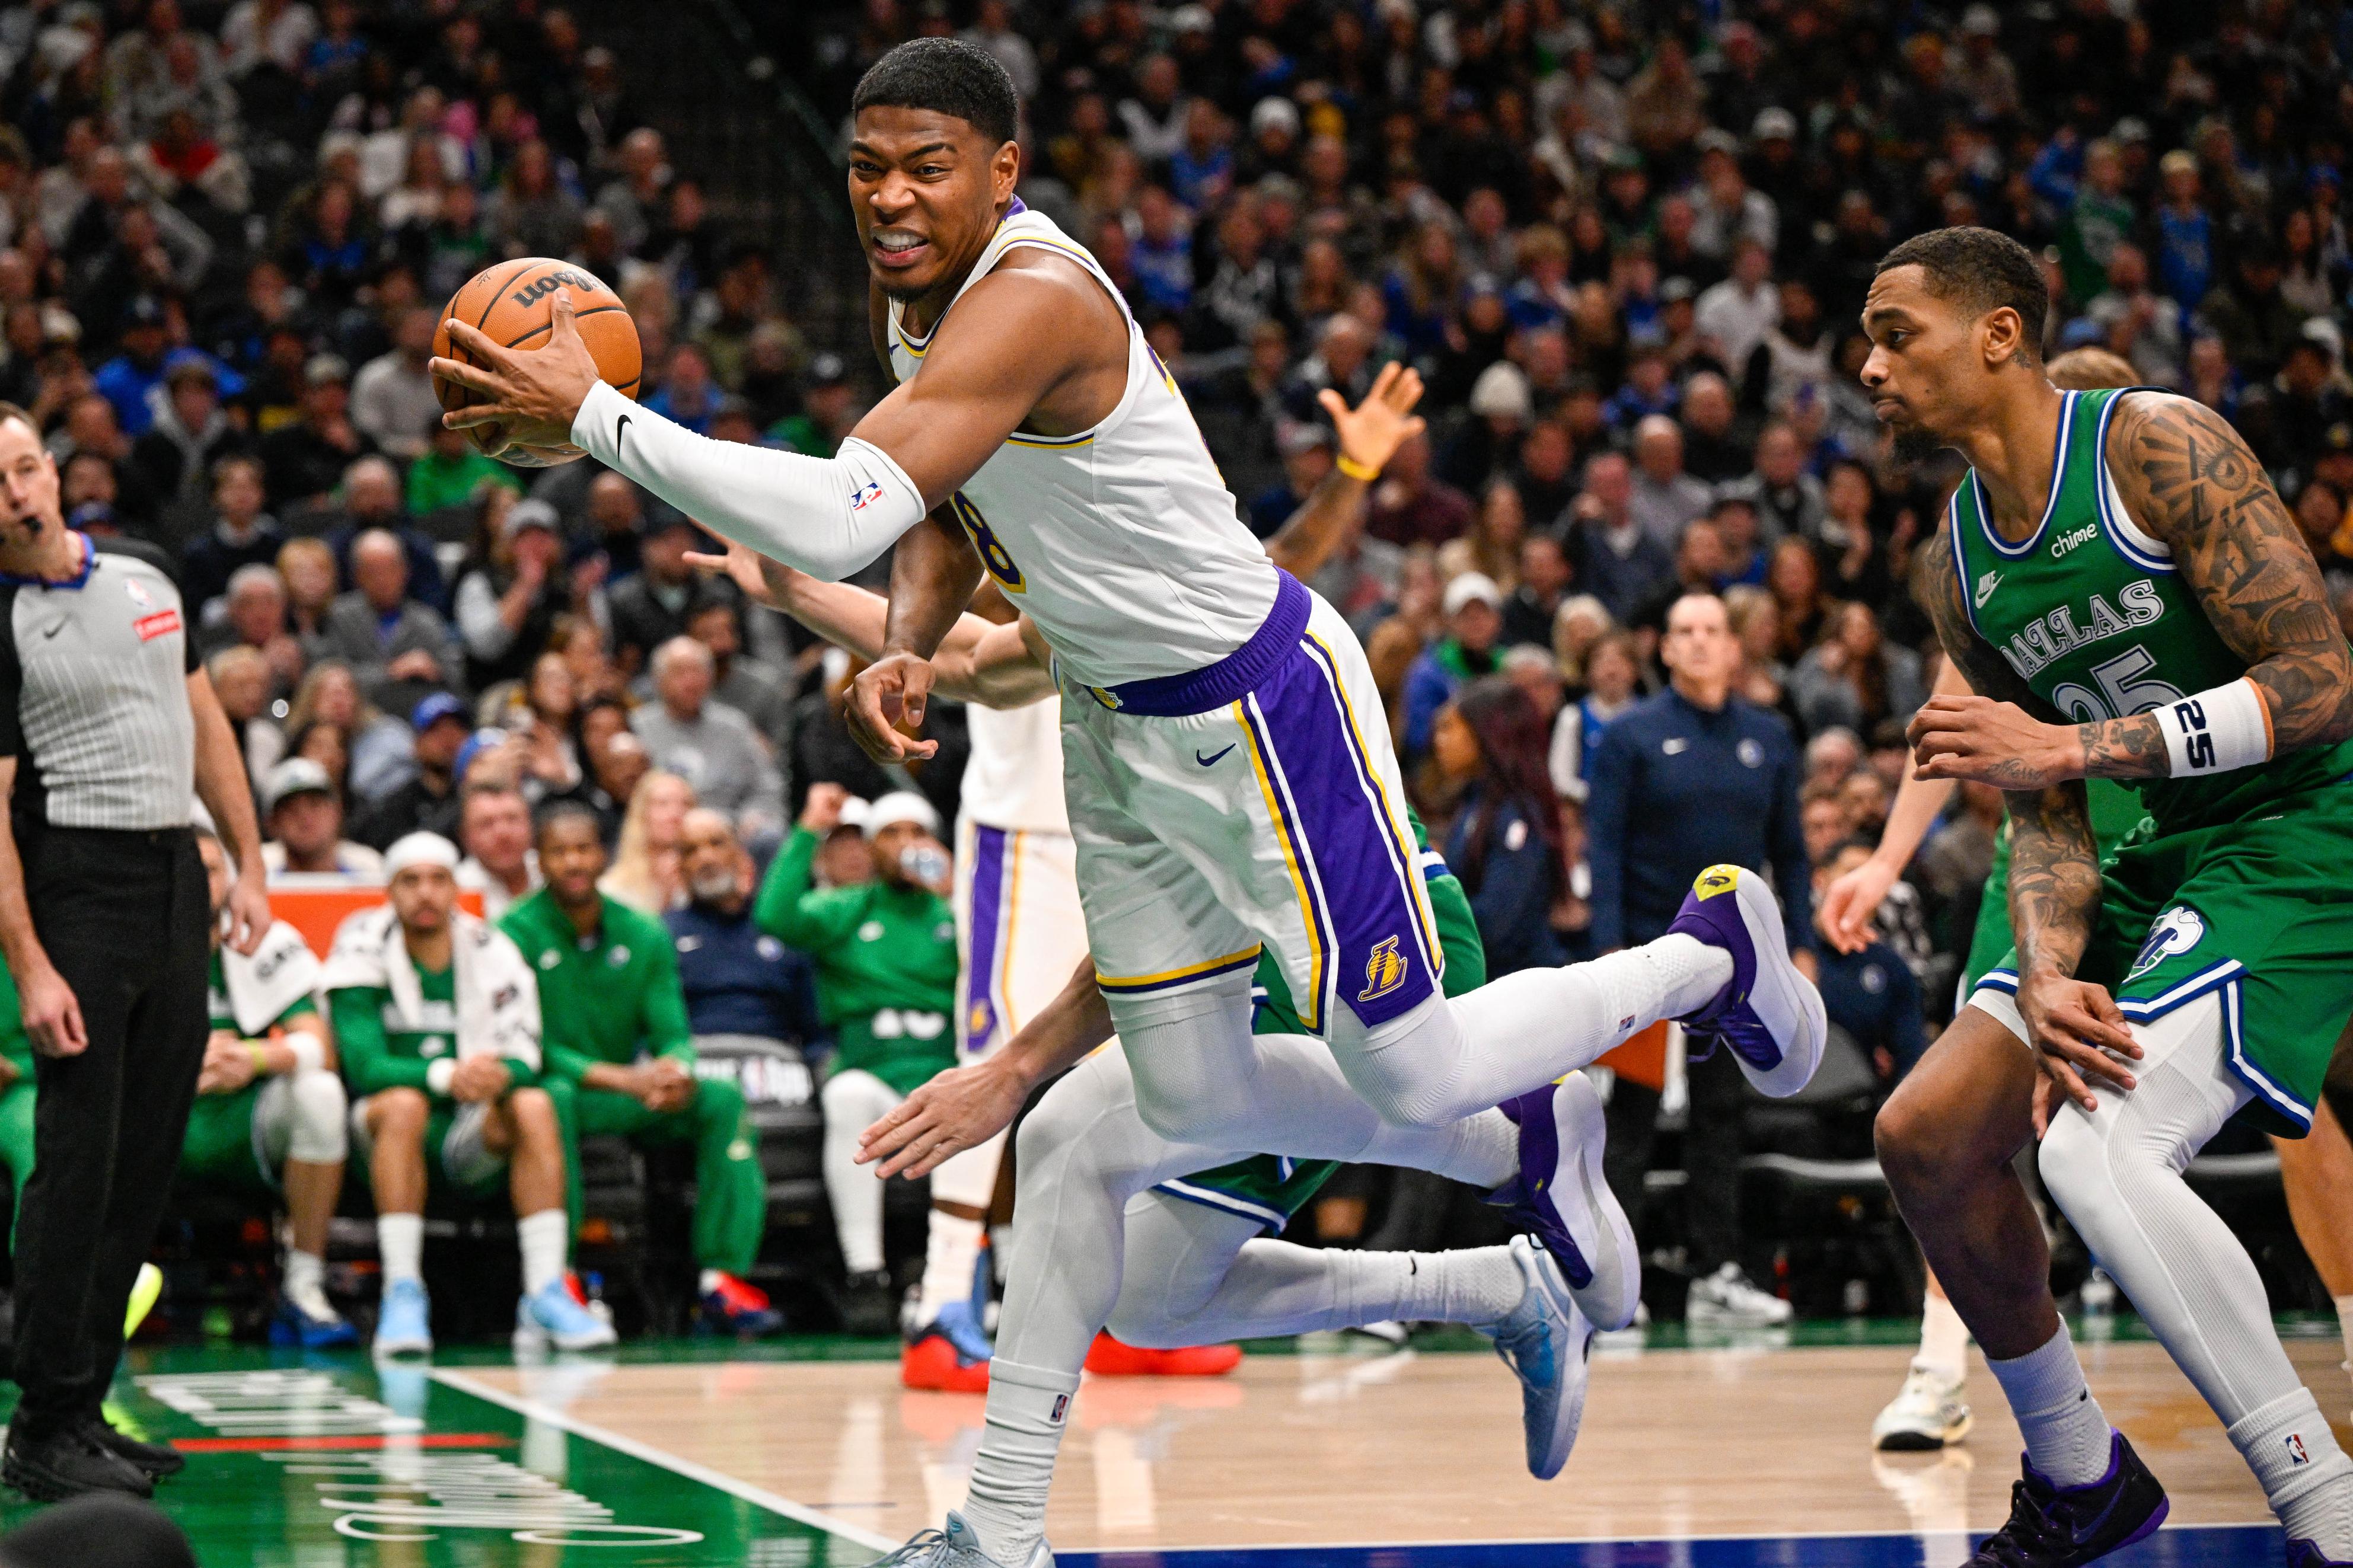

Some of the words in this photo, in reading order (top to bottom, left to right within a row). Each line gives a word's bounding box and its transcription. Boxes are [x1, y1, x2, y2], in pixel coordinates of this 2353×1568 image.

[511, 270, 612, 308] lson
[950, 490, 1026, 594] 8
[2051, 523, 2098, 558] chime
[1977, 570, 1996, 595] NIKE
[2173, 700, 2216, 769] 25
